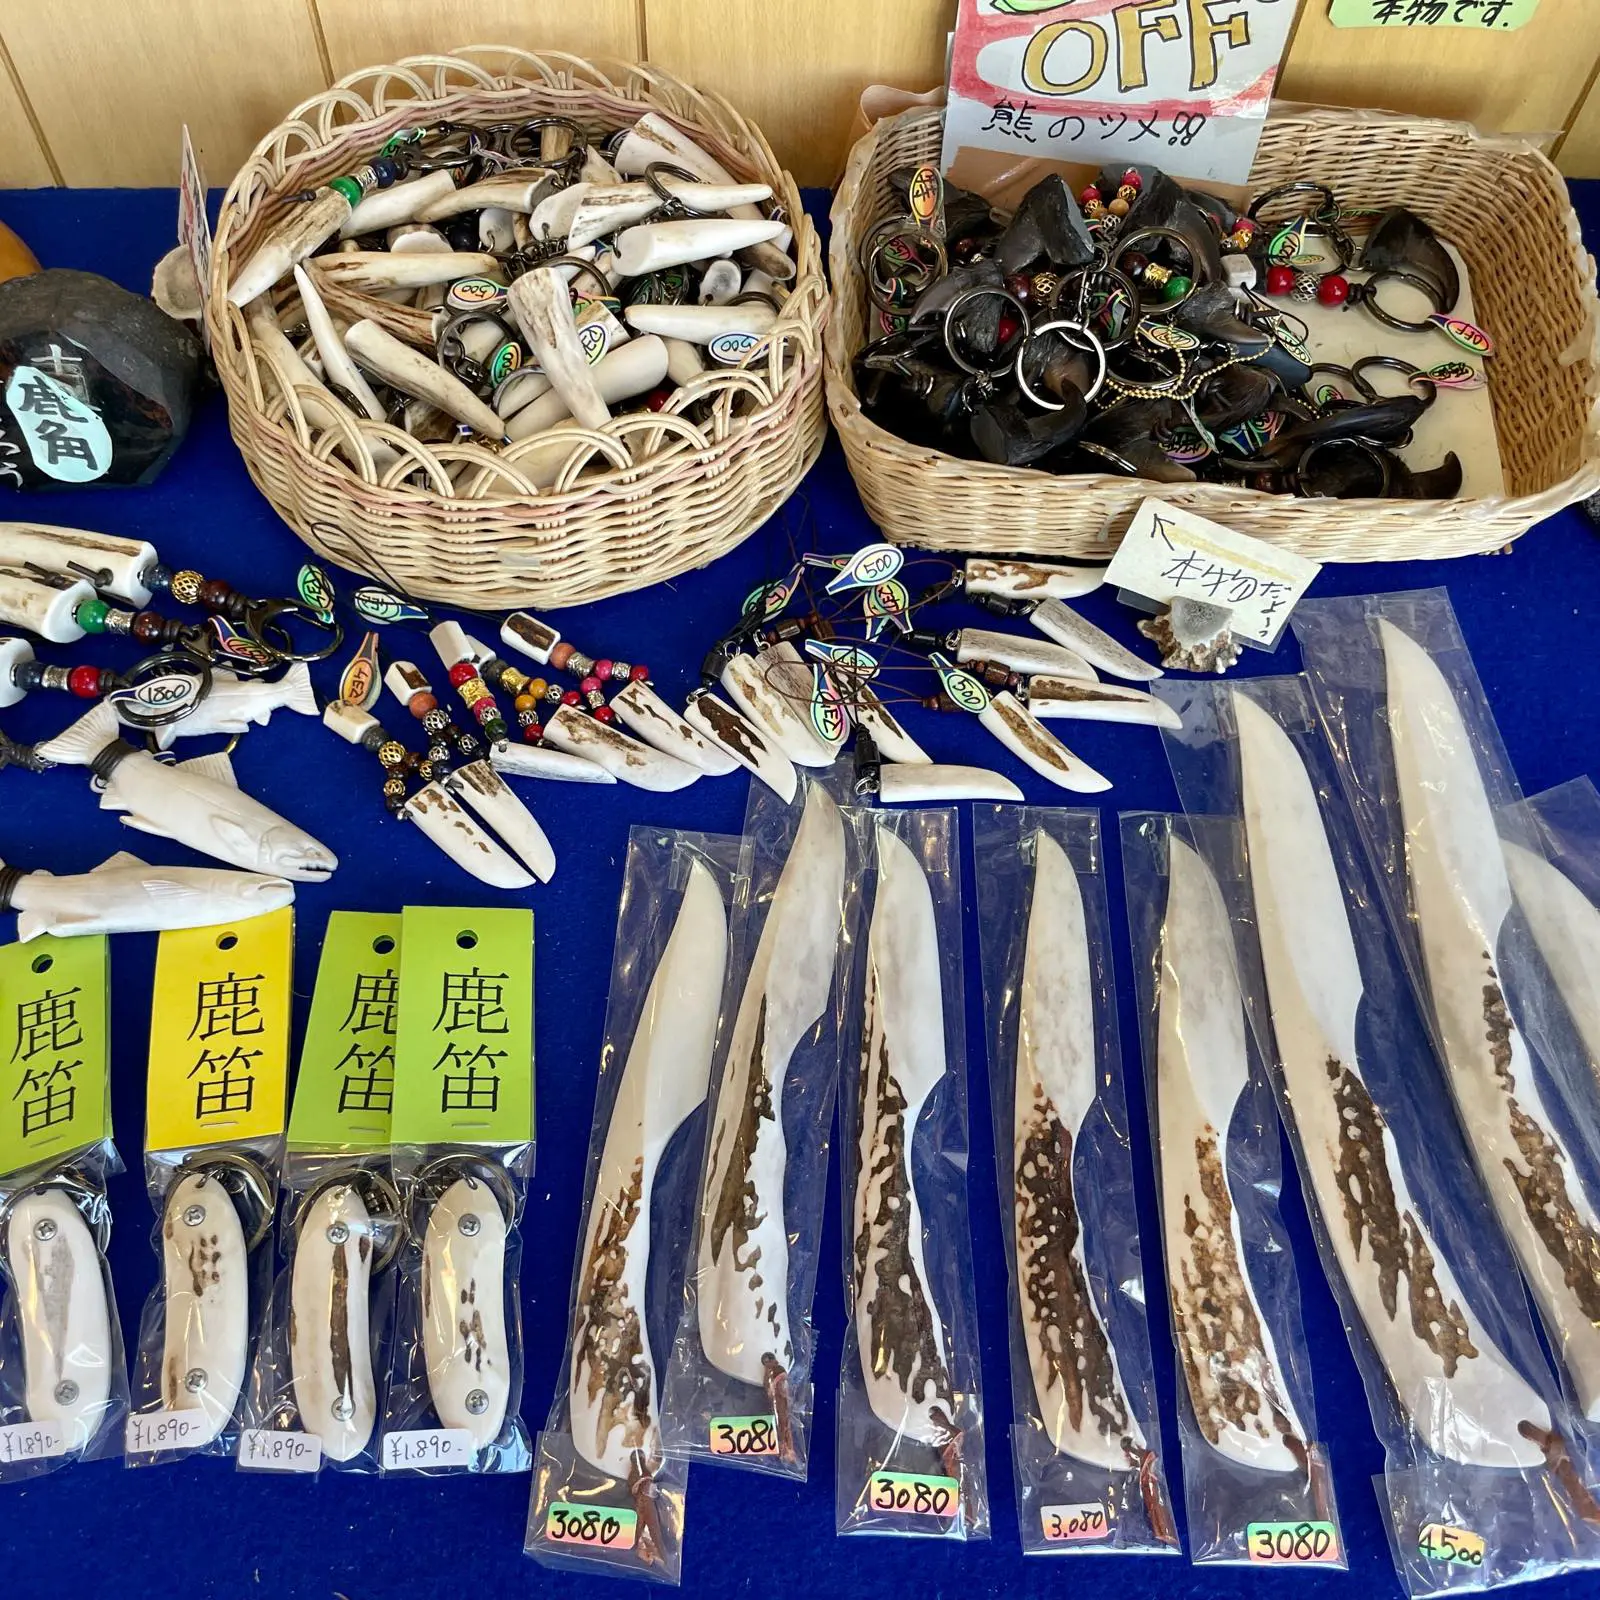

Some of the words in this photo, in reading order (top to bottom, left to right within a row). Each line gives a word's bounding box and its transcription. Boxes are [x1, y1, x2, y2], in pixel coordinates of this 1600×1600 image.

[1022, 0, 1250, 96] OFF
[461, 282, 490, 298] 500
[864, 554, 892, 577] 500
[149, 682, 188, 702] 1800
[952, 673, 981, 705] 500
[187, 972, 265, 1119] 鹿笛
[433, 967, 510, 1113] 鹿笛
[10, 986, 83, 1137] 鹿笛
[875, 1479, 950, 1514] 3080
[552, 1509, 620, 1544] 3080
[1052, 1510, 1103, 1537] 3.080
[1255, 1522, 1330, 1560] 3080
